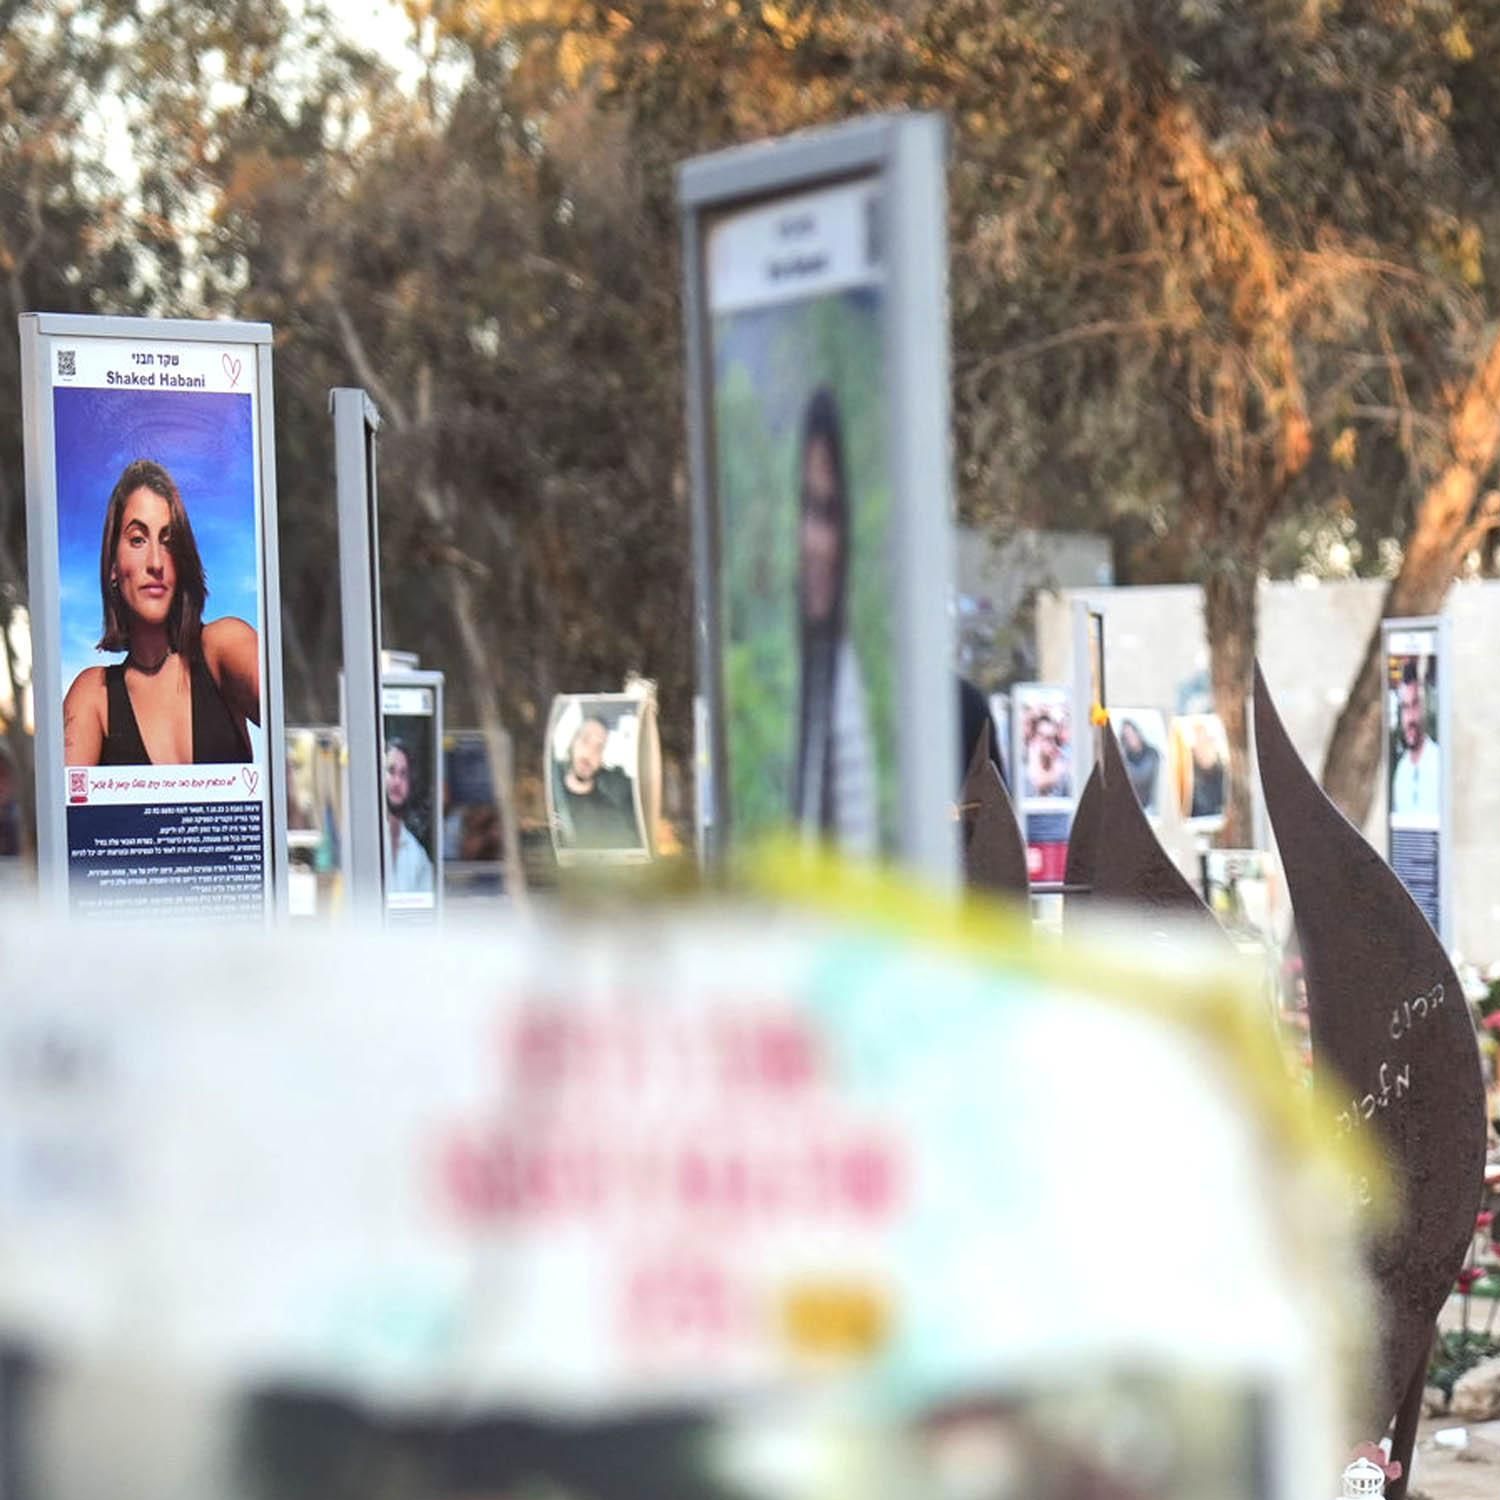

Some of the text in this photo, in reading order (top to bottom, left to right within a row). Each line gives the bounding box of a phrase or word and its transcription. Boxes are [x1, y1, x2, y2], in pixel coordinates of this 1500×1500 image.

[157, 353, 180, 368] שקד
[106, 370, 206, 388] Shaked Habani
